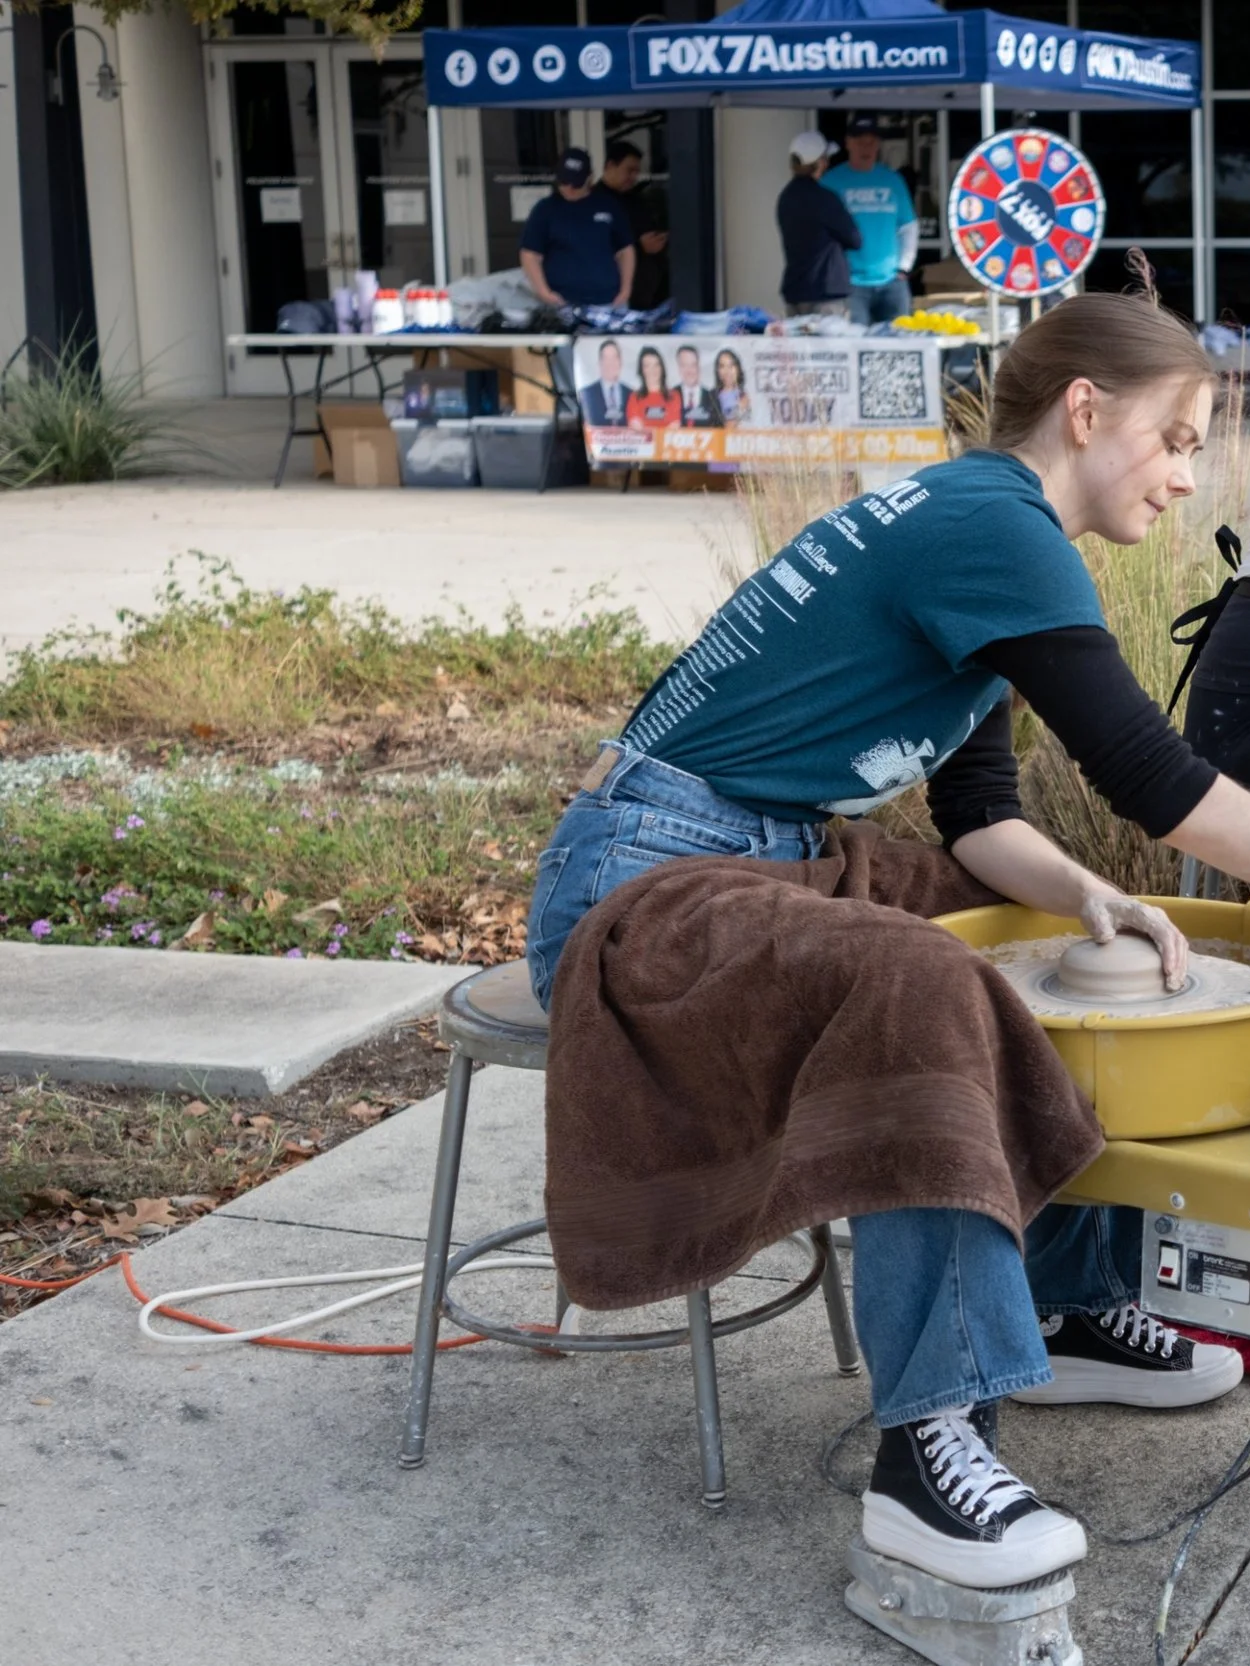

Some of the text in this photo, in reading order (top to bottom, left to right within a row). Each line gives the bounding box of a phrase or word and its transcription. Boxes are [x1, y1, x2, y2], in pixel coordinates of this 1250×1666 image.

[894, 487, 931, 516] PROJECT
[862, 497, 896, 526] 2025
[1188, 1251, 1199, 1260] ON
[1187, 1282, 1201, 1292] OFF
